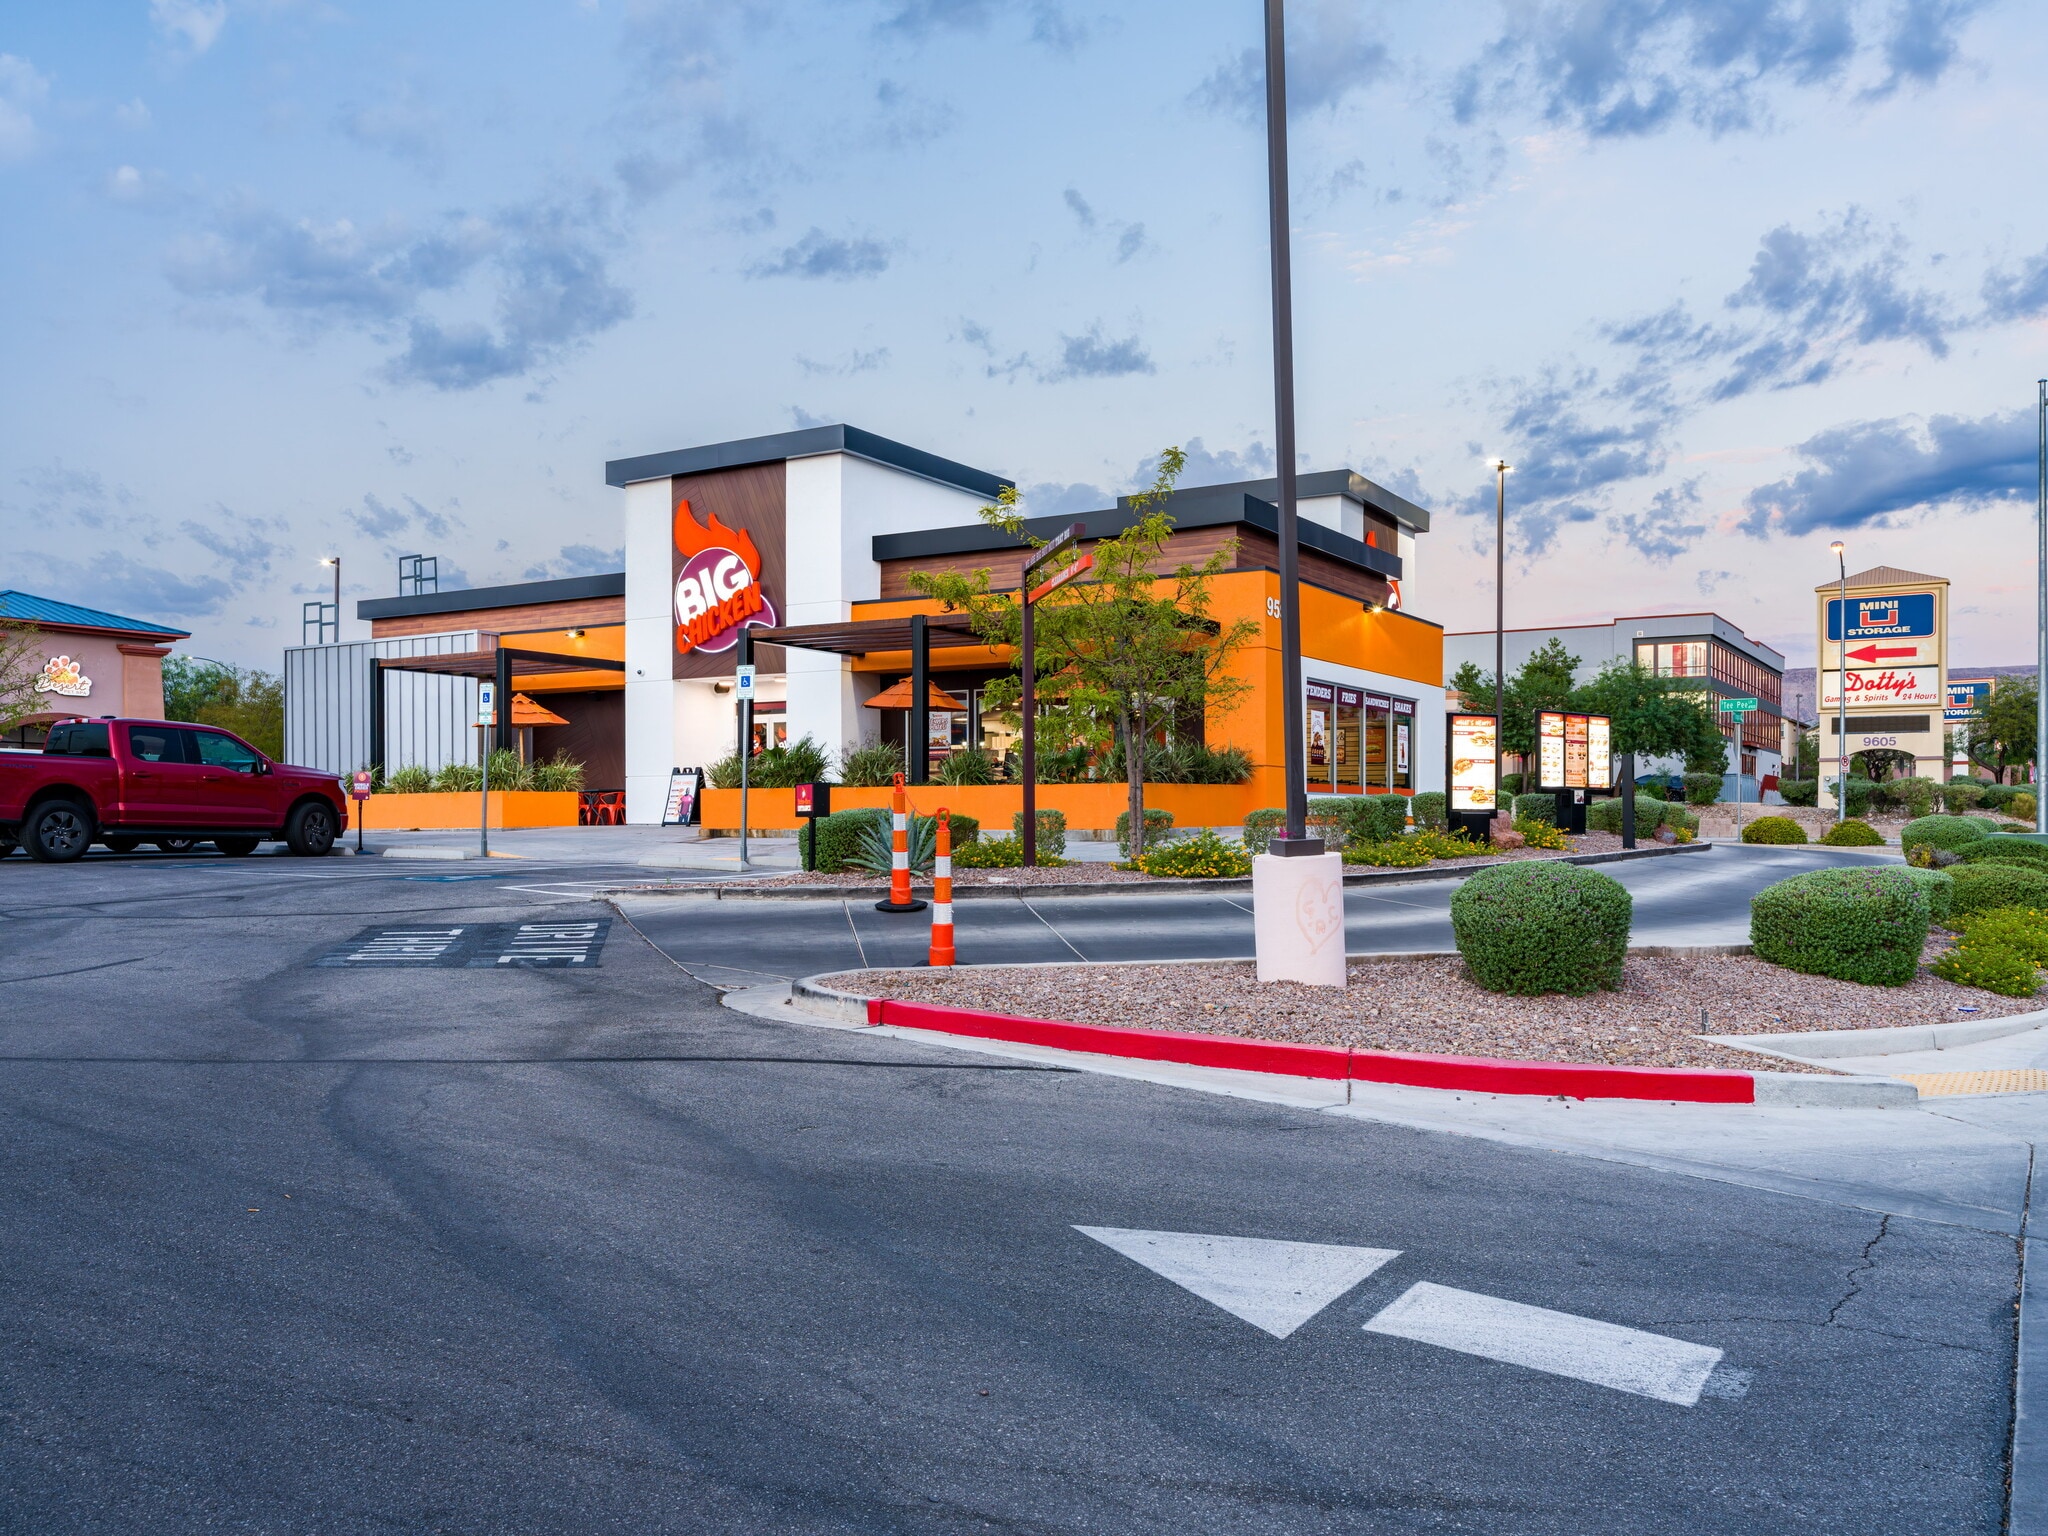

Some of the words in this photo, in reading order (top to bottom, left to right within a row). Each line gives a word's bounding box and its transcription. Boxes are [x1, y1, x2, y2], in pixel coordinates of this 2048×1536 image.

[676, 555, 749, 627] BIG
[1266, 596, 1281, 619] 95
[1859, 600, 1899, 611] MINI
[677, 581, 763, 654] CHICKEN
[1847, 625, 1911, 636] STORAGE
[37, 673, 87, 691] Desert
[1844, 671, 1917, 697] Dotty's
[1306, 684, 1332, 700] TENDERS
[1947, 686, 1974, 695] MINI
[1341, 691, 1357, 704] FRIES
[1824, 695, 1851, 704] Gamg
[1854, 694, 1860, 702] &
[1864, 693, 1889, 703] Spirits
[1914, 692, 1937, 700] Hours
[1394, 701, 1412, 714] SHAKES
[1723, 701, 1734, 709] Tee
[1736, 700, 1748, 709] Pee
[1944, 708, 1983, 717] TORAGE
[1863, 736, 1897, 747] 9605
[346, 928, 464, 960] THRU
[498, 922, 599, 963] DRIVE
